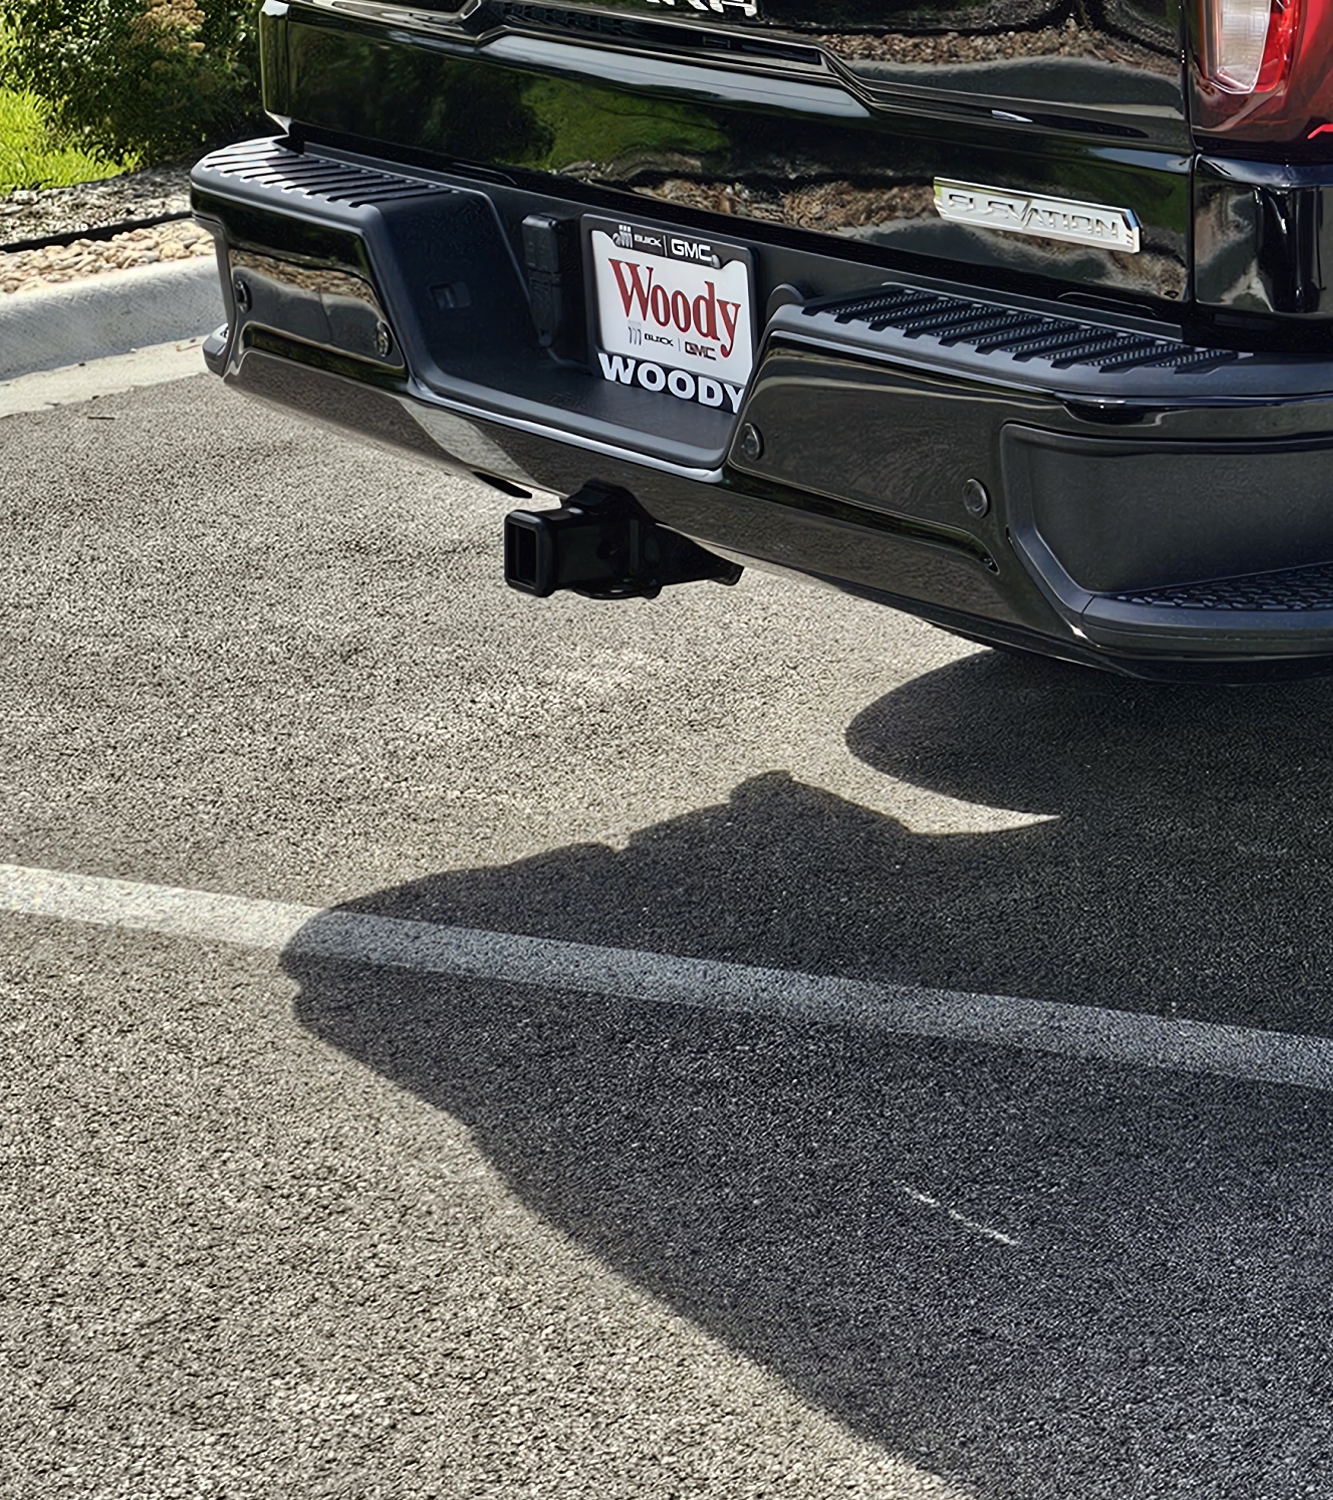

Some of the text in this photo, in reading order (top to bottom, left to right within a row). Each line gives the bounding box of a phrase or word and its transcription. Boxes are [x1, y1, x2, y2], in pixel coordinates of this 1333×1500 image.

[670, 238, 713, 261] GMC
[608, 258, 741, 358] Woody
[684, 341, 717, 361] GMC
[597, 352, 745, 415] WOODY
